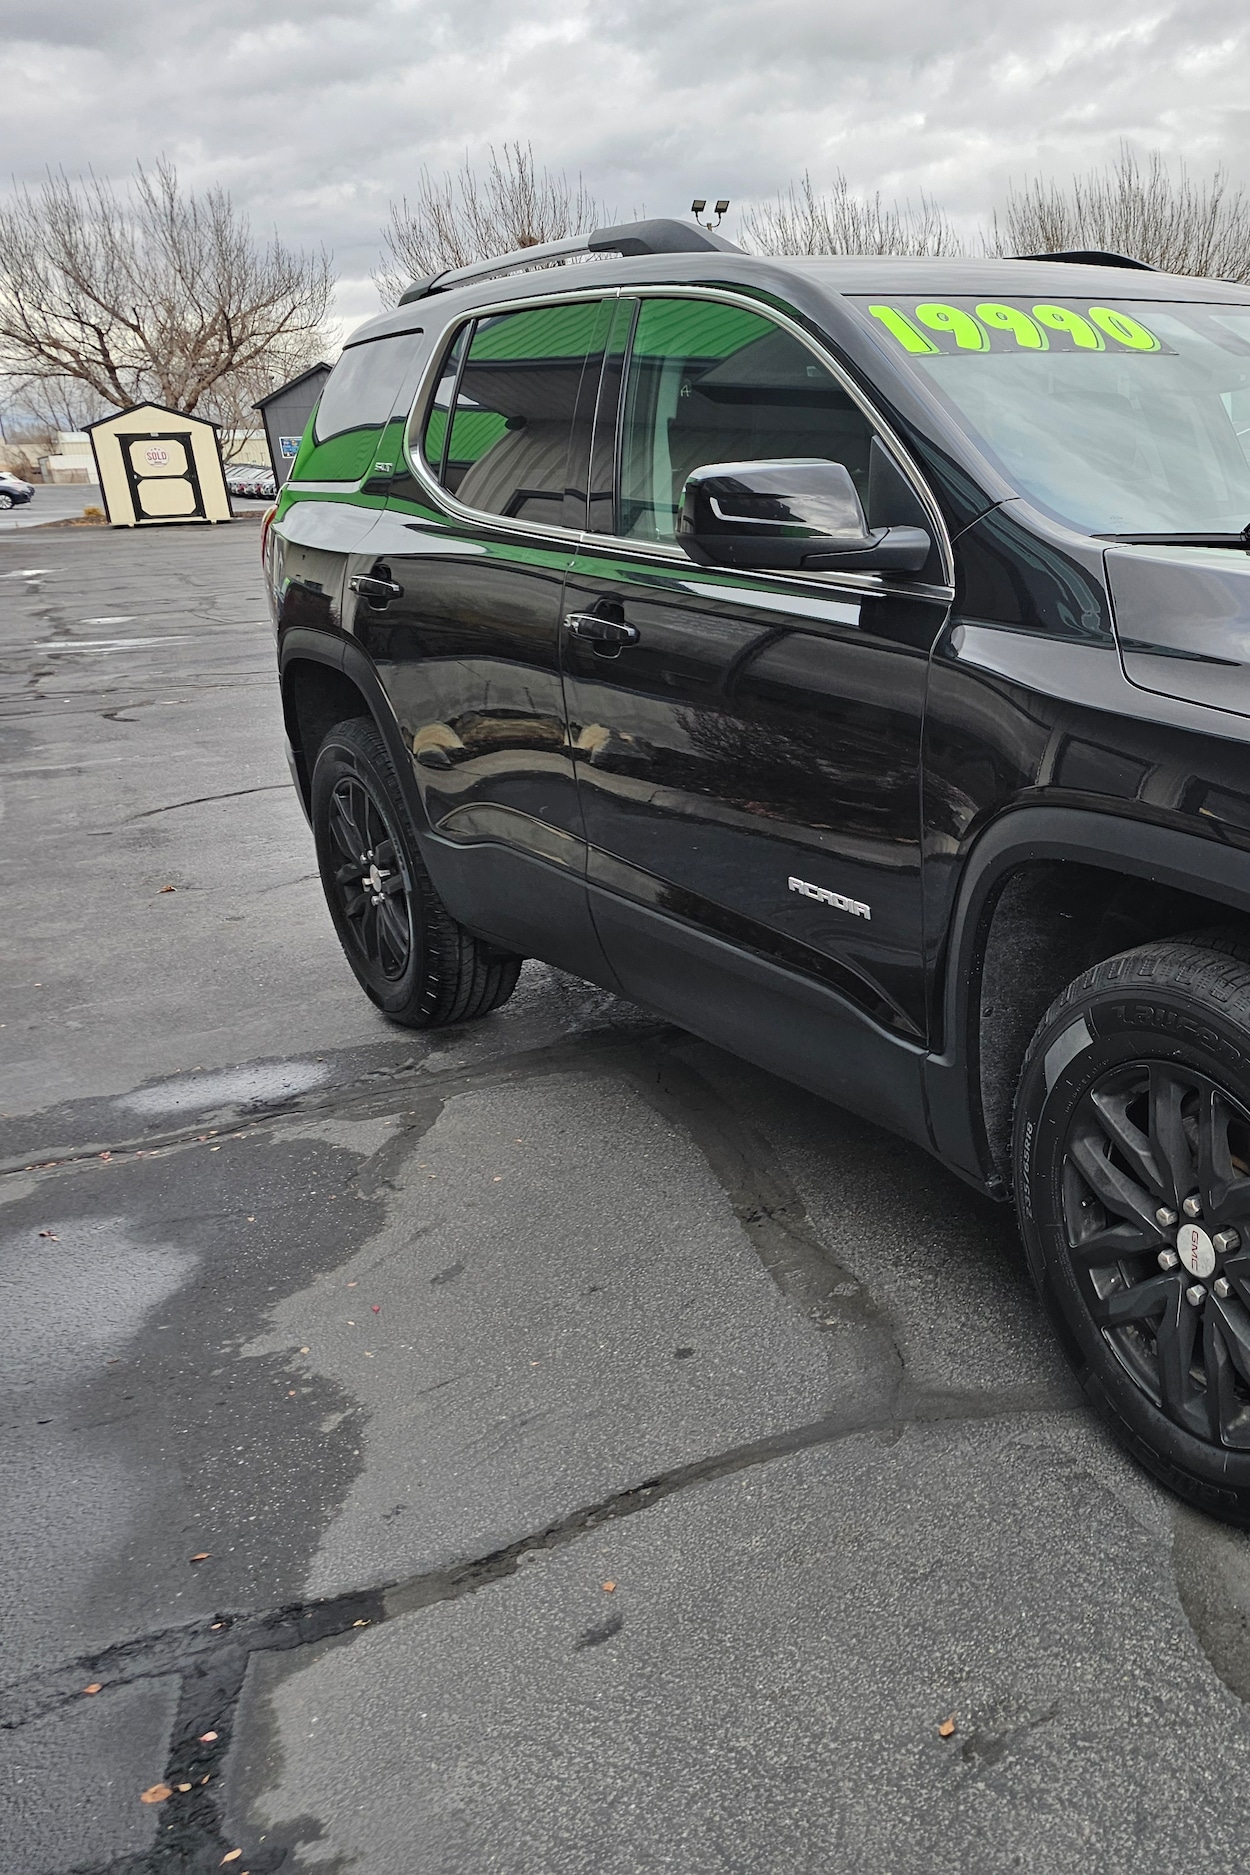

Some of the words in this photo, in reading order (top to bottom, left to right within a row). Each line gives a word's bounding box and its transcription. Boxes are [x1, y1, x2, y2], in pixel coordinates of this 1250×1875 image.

[868, 302, 1161, 352] 19990
[146, 451, 167, 461] SOLD
[788, 876, 872, 920] ACADIA
[1191, 1230, 1199, 1272] GMC
